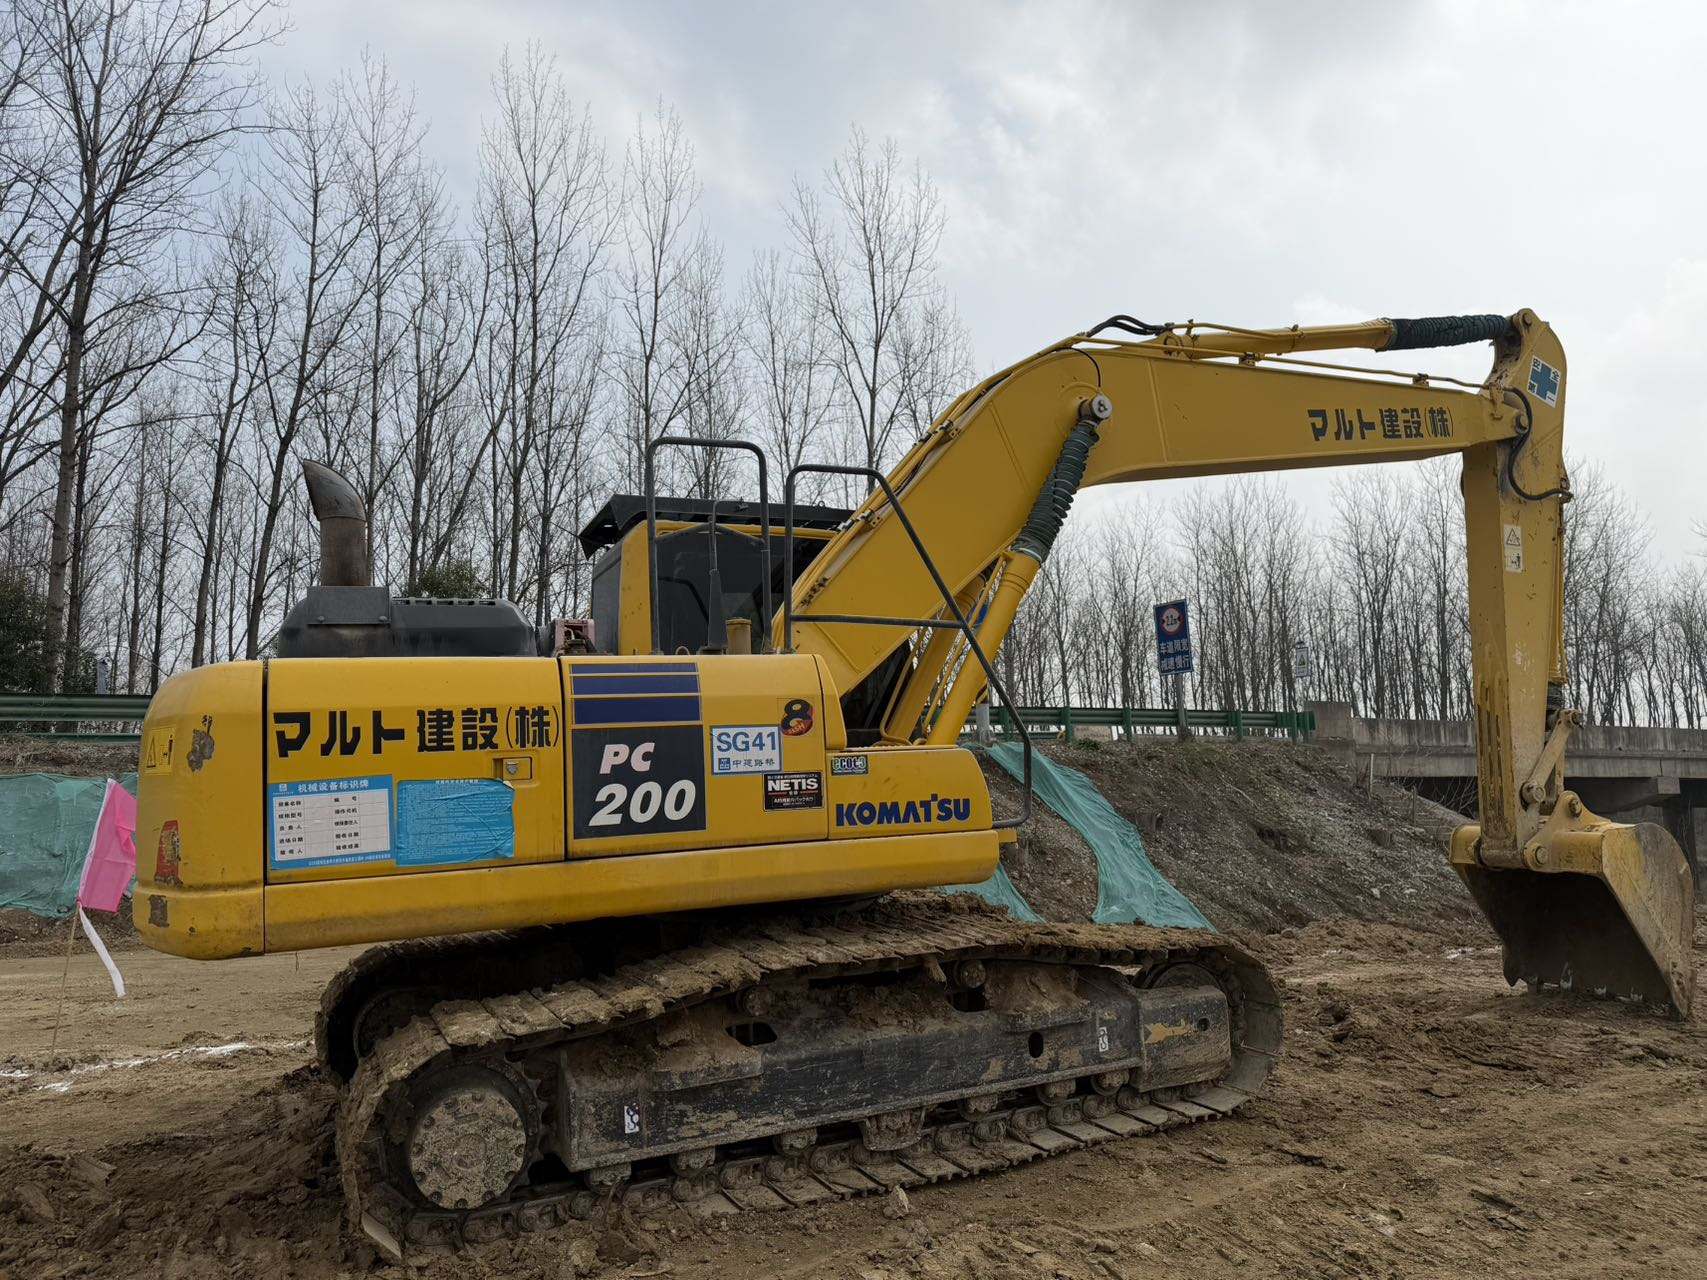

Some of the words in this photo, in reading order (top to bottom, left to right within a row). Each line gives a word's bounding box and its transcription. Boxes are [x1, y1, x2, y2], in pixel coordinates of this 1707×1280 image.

[1307, 406, 1454, 441] マルト建設(株)
[272, 705, 560, 758] マルト建設(株)
[716, 731, 776, 752] SG41
[599, 742, 656, 775] PC
[298, 779, 369, 793] 机械设备标识牌
[767, 778, 819, 791] NETIS
[588, 779, 697, 827] 200
[836, 793, 971, 827] KOMATSU
